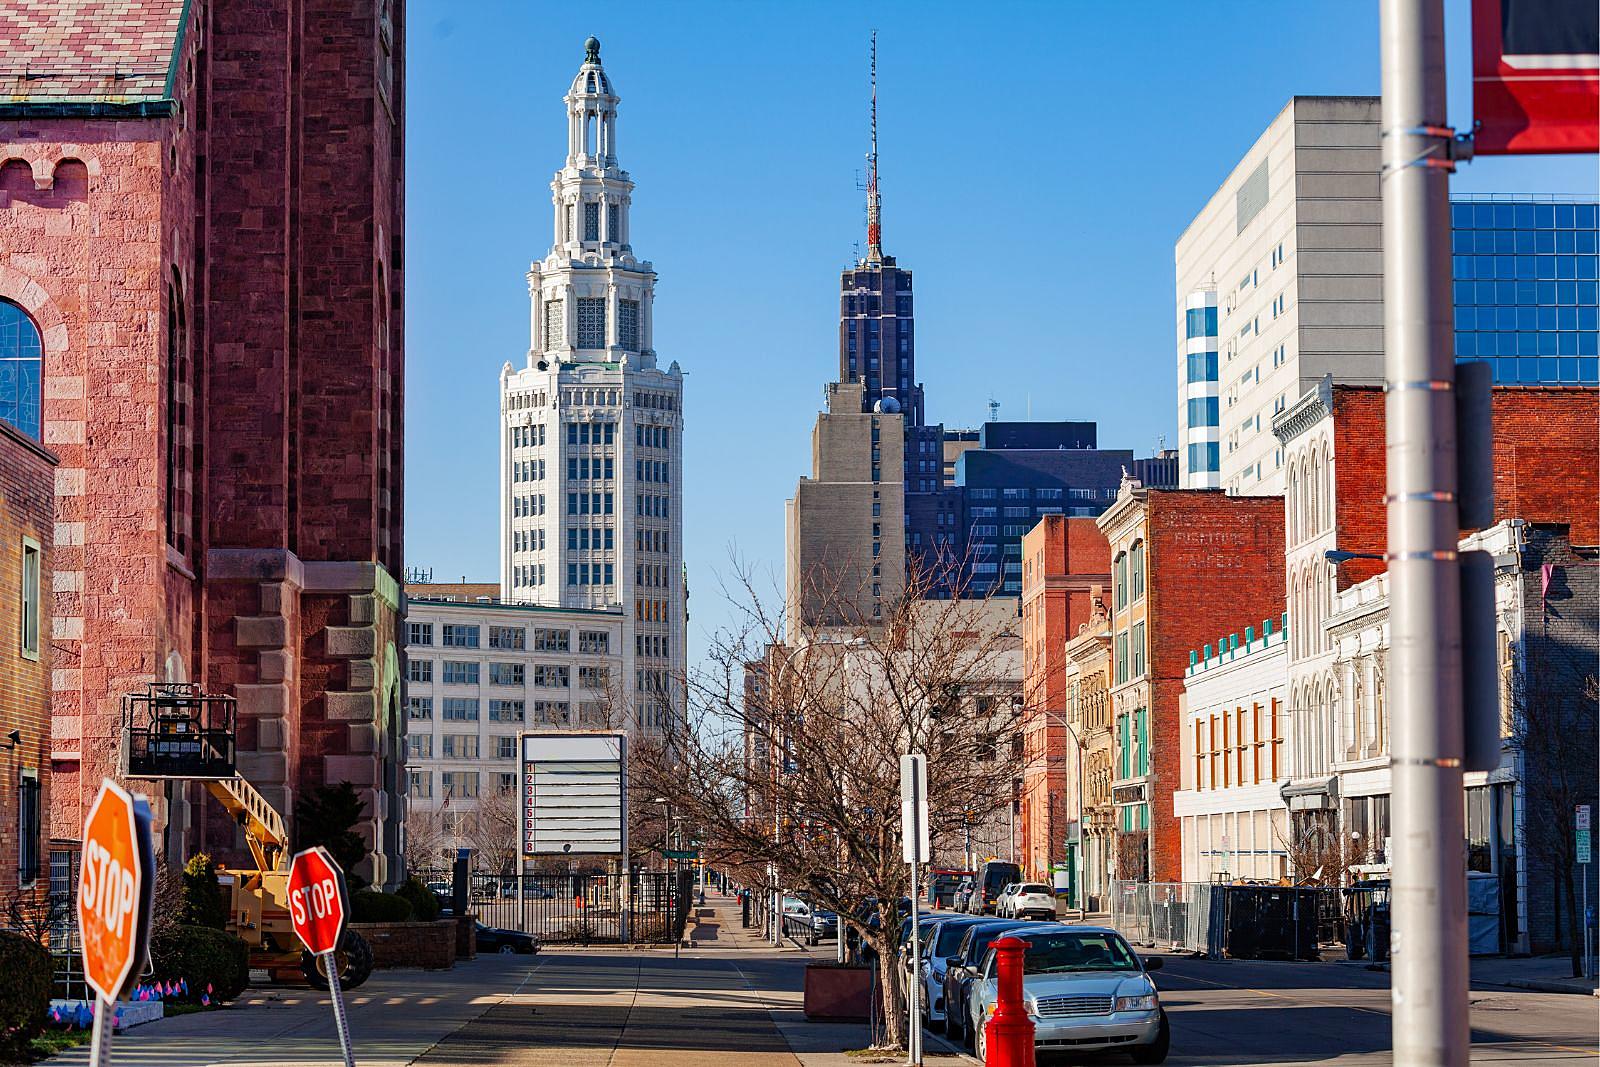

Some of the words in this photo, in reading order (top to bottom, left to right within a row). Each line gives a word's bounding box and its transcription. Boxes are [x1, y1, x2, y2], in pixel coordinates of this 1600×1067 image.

[527, 763, 533, 772] 1
[527, 775, 533, 783] 2
[527, 786, 533, 794] 3
[527, 797, 533, 806] 4
[527, 809, 533, 817] 5
[527, 820, 533, 829] 6
[527, 831, 533, 840] 7
[527, 842, 533, 851] 8
[83, 838, 134, 939] STOP
[292, 878, 334, 925] STOP
